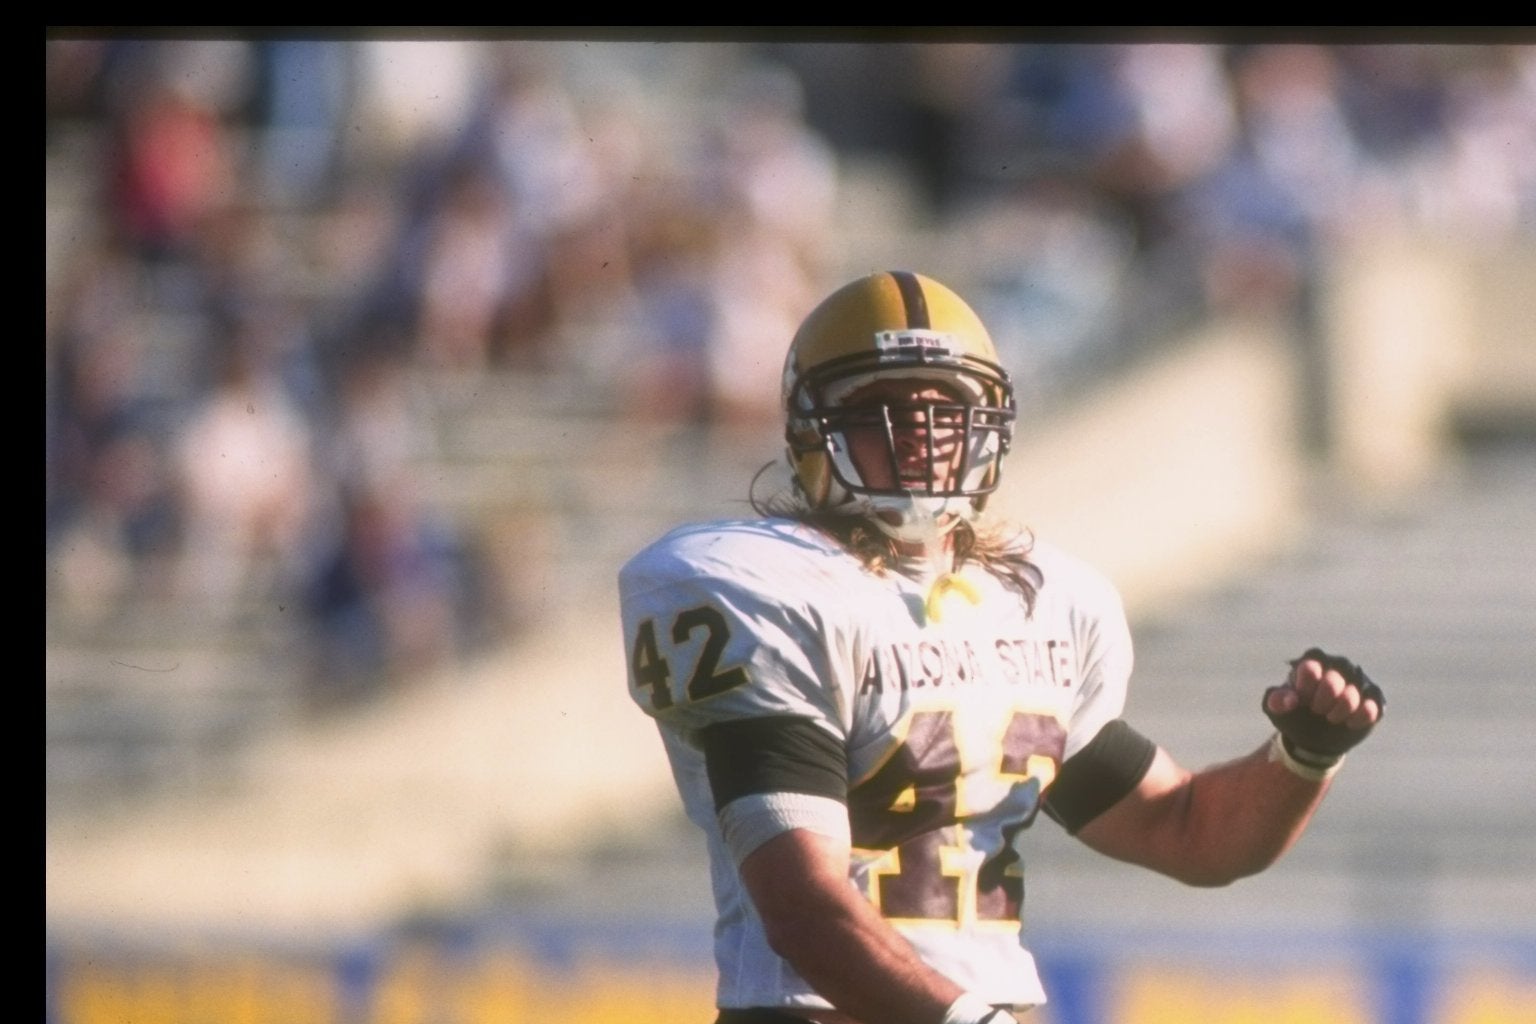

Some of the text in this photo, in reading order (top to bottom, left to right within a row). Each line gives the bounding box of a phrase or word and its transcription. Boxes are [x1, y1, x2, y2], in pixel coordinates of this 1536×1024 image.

[631, 604, 752, 711] 42
[994, 637, 1073, 690] STATE
[848, 707, 1070, 931] 42
